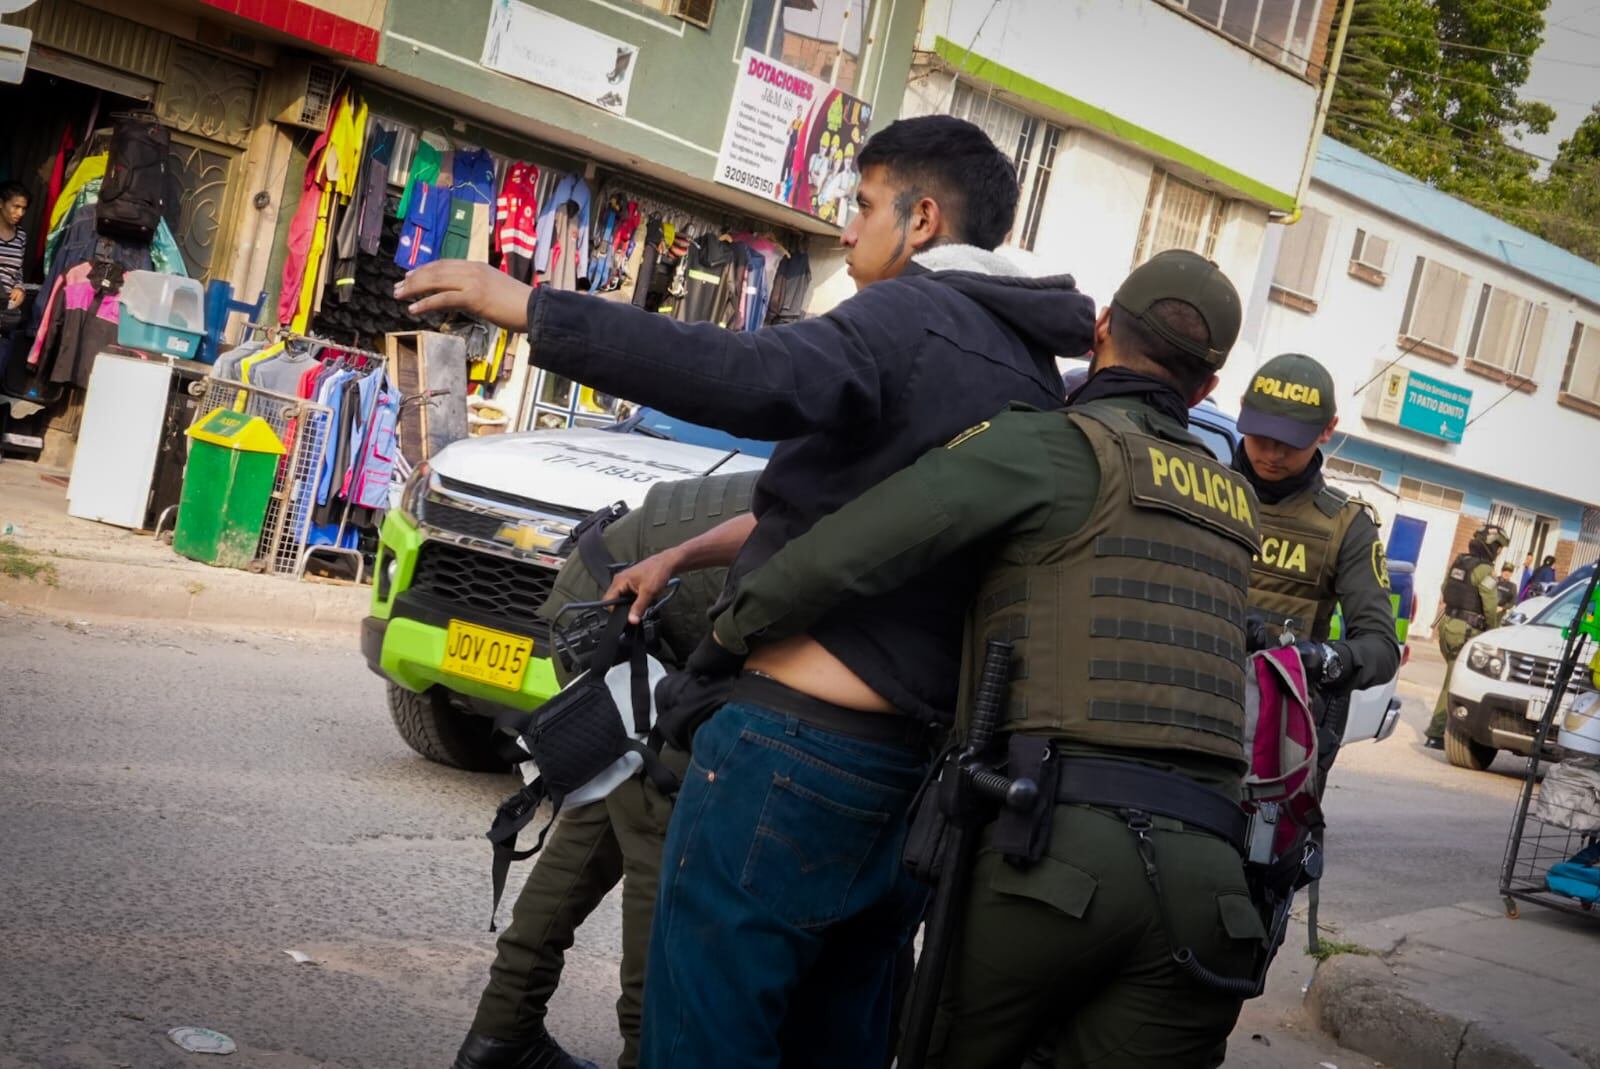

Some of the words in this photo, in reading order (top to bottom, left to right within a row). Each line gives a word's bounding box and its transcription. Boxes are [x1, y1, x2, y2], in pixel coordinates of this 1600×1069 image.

[747, 56, 814, 101] DOTACIONES
[761, 87, 782, 108] J&M
[724, 165, 774, 193] 3209105150
[1253, 375, 1321, 406] POLICIA
[1417, 394, 1438, 411] PATIO
[1438, 401, 1465, 420] BONITO
[542, 453, 661, 483] 17-1-1933
[1148, 447, 1255, 529] POLICIA
[487, 641, 526, 674] 015
